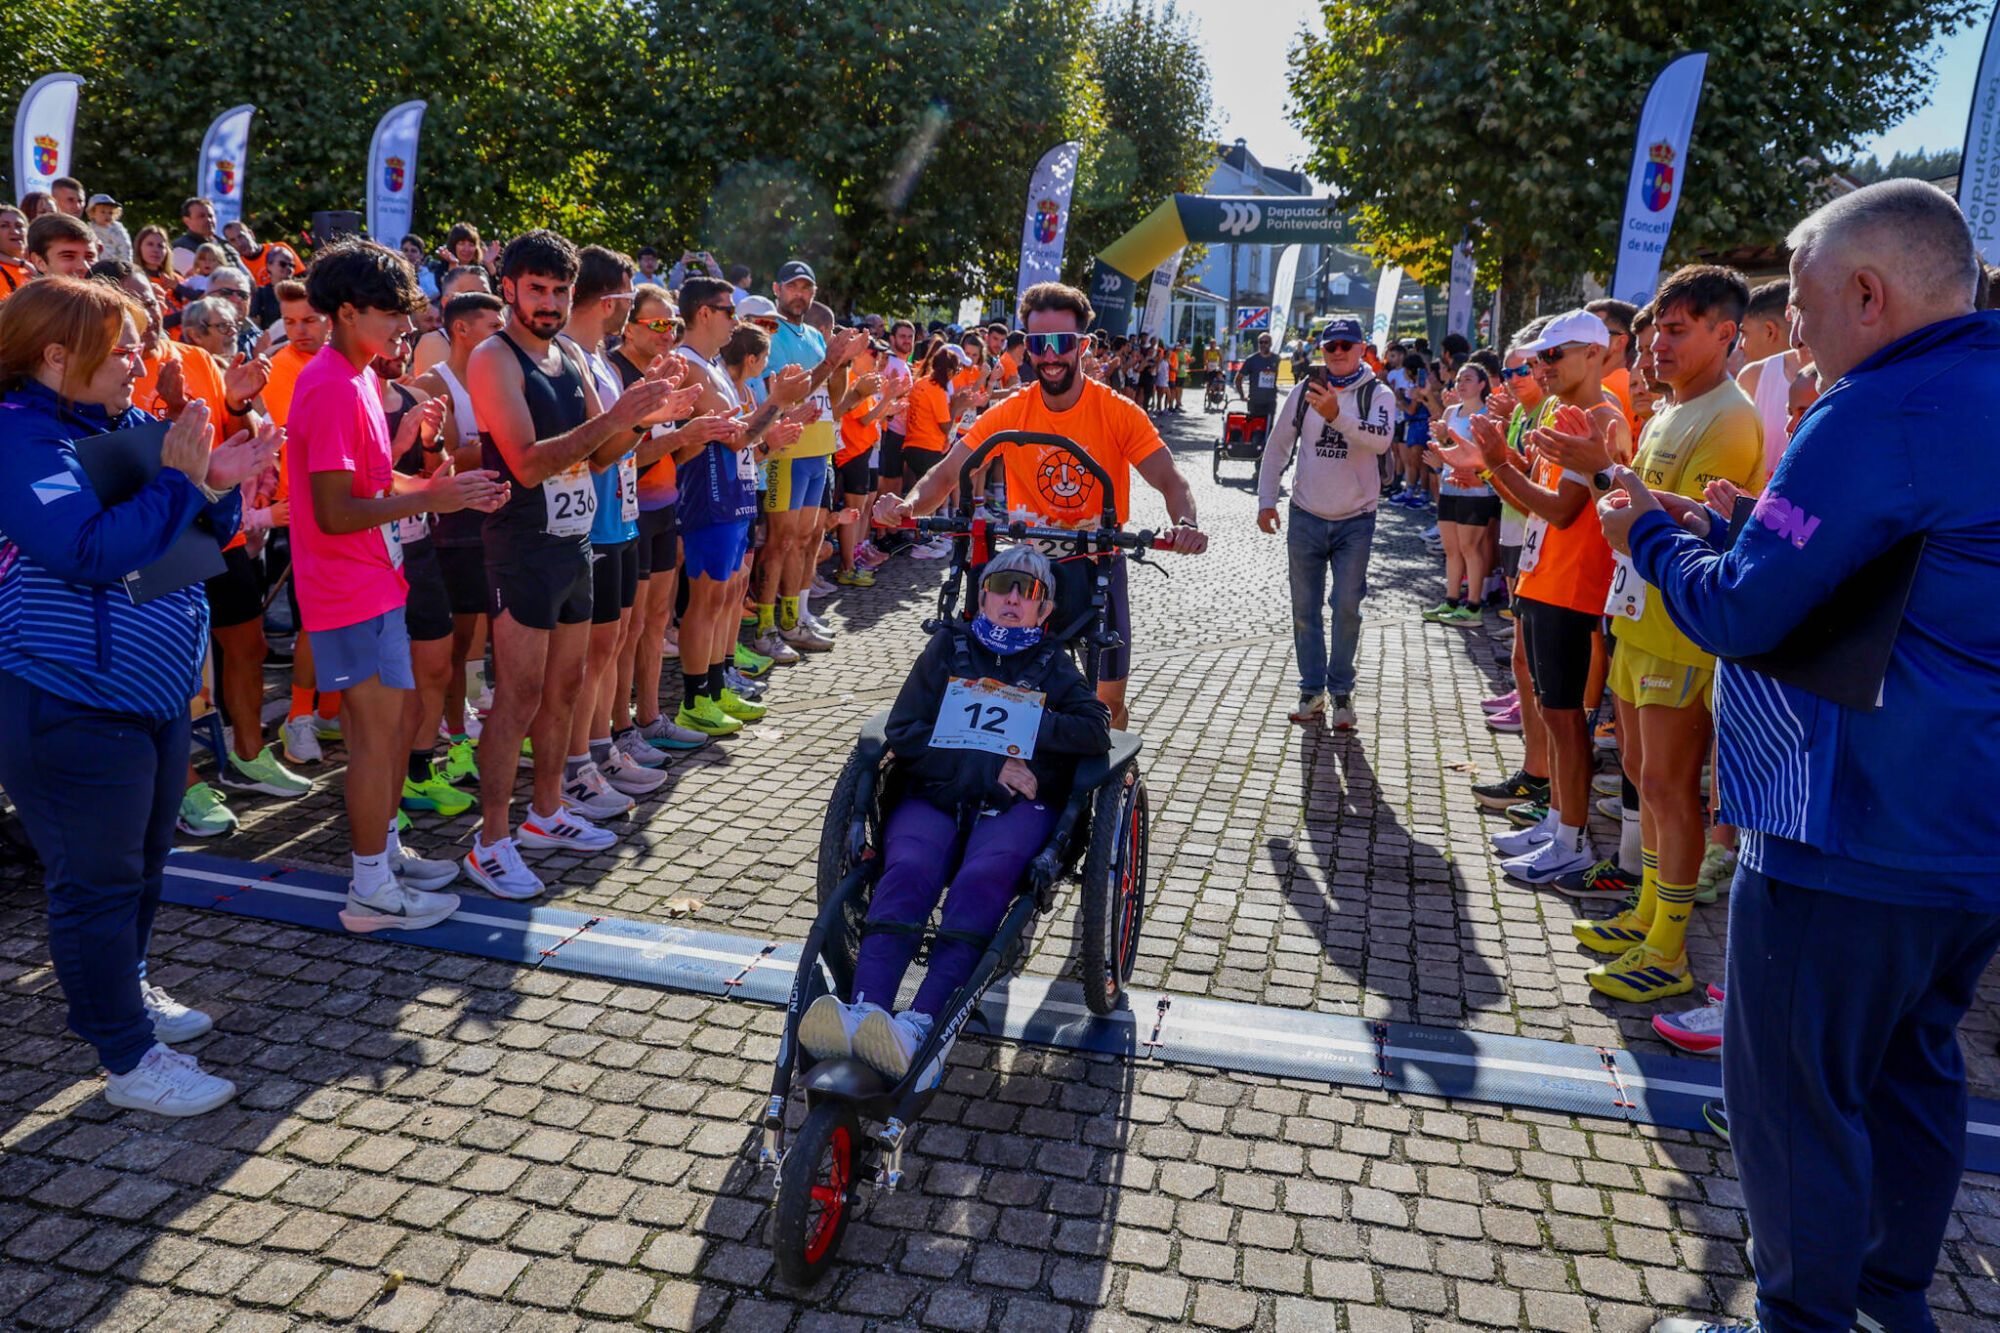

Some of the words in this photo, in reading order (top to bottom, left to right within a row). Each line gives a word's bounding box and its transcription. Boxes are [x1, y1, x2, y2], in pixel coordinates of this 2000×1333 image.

[1266, 218, 1342, 230] Pontevedra
[1627, 239, 1640, 251] de
[810, 395, 833, 411] 70
[1315, 447, 1348, 460] VADER
[554, 487, 595, 520] 236
[963, 702, 1009, 735] 12
